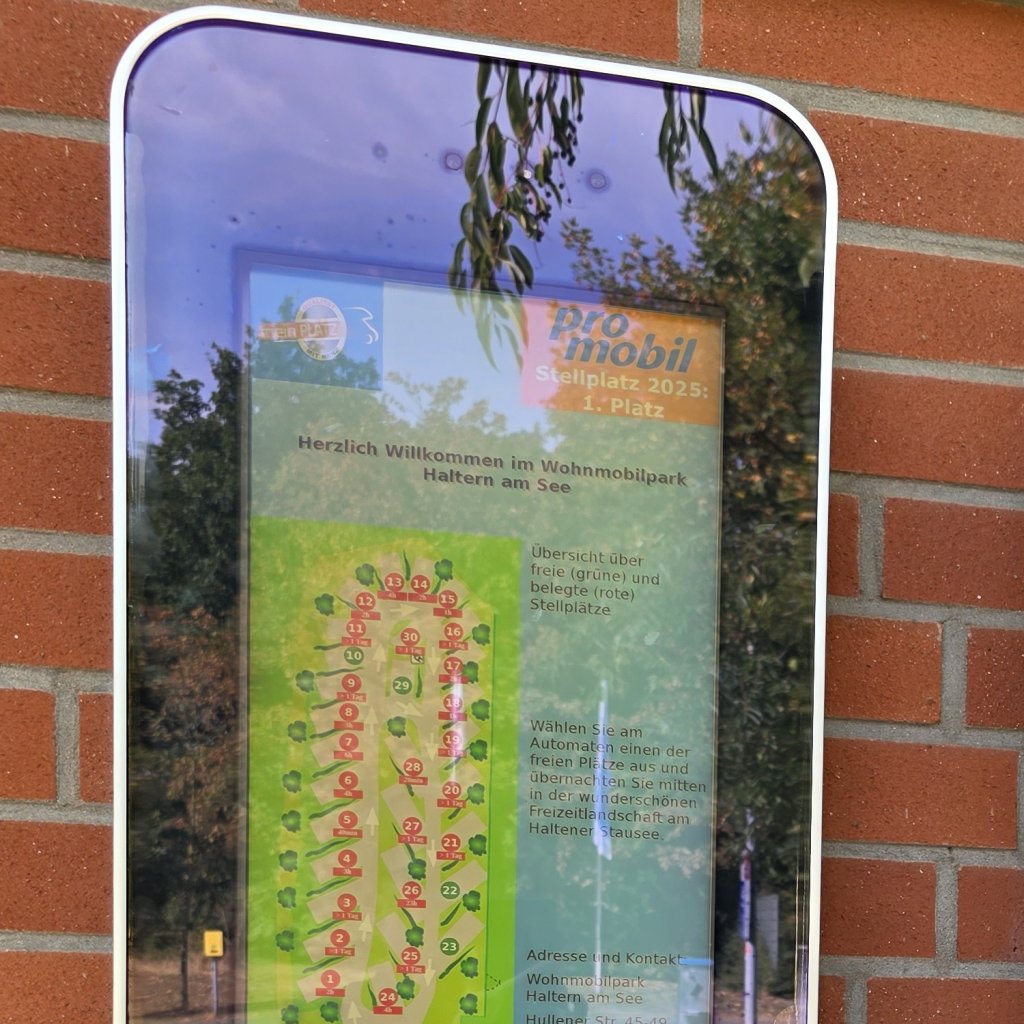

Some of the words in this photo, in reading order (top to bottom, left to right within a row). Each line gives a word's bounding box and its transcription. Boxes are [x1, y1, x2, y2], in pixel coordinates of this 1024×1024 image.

[549, 307, 629, 341] pro
[564, 333, 697, 374] mobil
[535, 365, 640, 393] Stellplatz
[647, 376, 708, 399] 2025:
[582, 395, 602, 412] 1.
[610, 396, 665, 419] Platz
[298, 435, 378, 456] Herzlich
[384, 444, 504, 469] Willkommen
[511, 455, 535, 472] im
[540, 459, 688, 488] Wohnmobilpark
[423, 468, 494, 487] Haltern
[501, 476, 530, 491] am
[536, 479, 571, 495] See
[532, 543, 605, 564] Übersicht
[609, 552, 644, 567] über
[530, 563, 565, 578] freie
[571, 567, 626, 584] (grüne)
[632, 573, 660, 586] und
[387, 577, 402, 587] 13
[413, 579, 428, 589] 14
[530, 581, 588, 598] belegte
[594, 586, 635, 601] (rote)
[358, 596, 373, 606] 12
[441, 594, 455, 604] 15
[530, 598, 611, 616] Stellplätze
[349, 623, 364, 633] 11
[446, 627, 461, 637] 16
[403, 632, 418, 642] 30
[347, 651, 362, 661] 10
[446, 661, 460, 671] 17
[347, 678, 355, 688] 9
[395, 681, 410, 690] 29
[345, 707, 352, 717] 8
[530, 719, 586, 735] Wählen
[592, 723, 615, 736] Sie
[620, 726, 643, 738] am
[345, 738, 352, 747] 7
[530, 737, 613, 753] Automaten
[620, 743, 660, 756] einen
[666, 745, 690, 758] der
[405, 762, 421, 772] 28
[530, 754, 573, 768] freien
[579, 756, 625, 771] Plätze
[629, 761, 655, 772] aus
[661, 762, 689, 774] und
[344, 776, 352, 785] 6
[530, 771, 626, 788] übernachten
[631, 777, 654, 790] Sie
[659, 778, 706, 793] mitten
[444, 785, 460, 795] 20
[530, 789, 543, 801] in
[548, 789, 574, 802] der
[579, 792, 697, 809] wunderschönen
[344, 815, 351, 824] 5
[529, 805, 663, 824] Freizeitlandschaft
[667, 813, 690, 825] am
[404, 821, 420, 831] 27
[529, 822, 594, 837] Haltener
[600, 825, 664, 841] Stausee.
[443, 838, 458, 847] 21
[343, 854, 351, 863] 4
[404, 885, 419, 895] 26
[442, 886, 458, 895] 22
[343, 898, 351, 907] 3
[336, 934, 344, 943] 2
[442, 942, 457, 951] 23
[403, 951, 418, 960] 25
[526, 949, 587, 962] Adresse
[593, 952, 620, 964] und
[327, 975, 334, 984] 1
[526, 973, 645, 989] Wohnmobilpark
[380, 993, 396, 1002] 24
[526, 990, 581, 1003] Haltern
[587, 994, 610, 1004] am
[616, 992, 643, 1005] See
